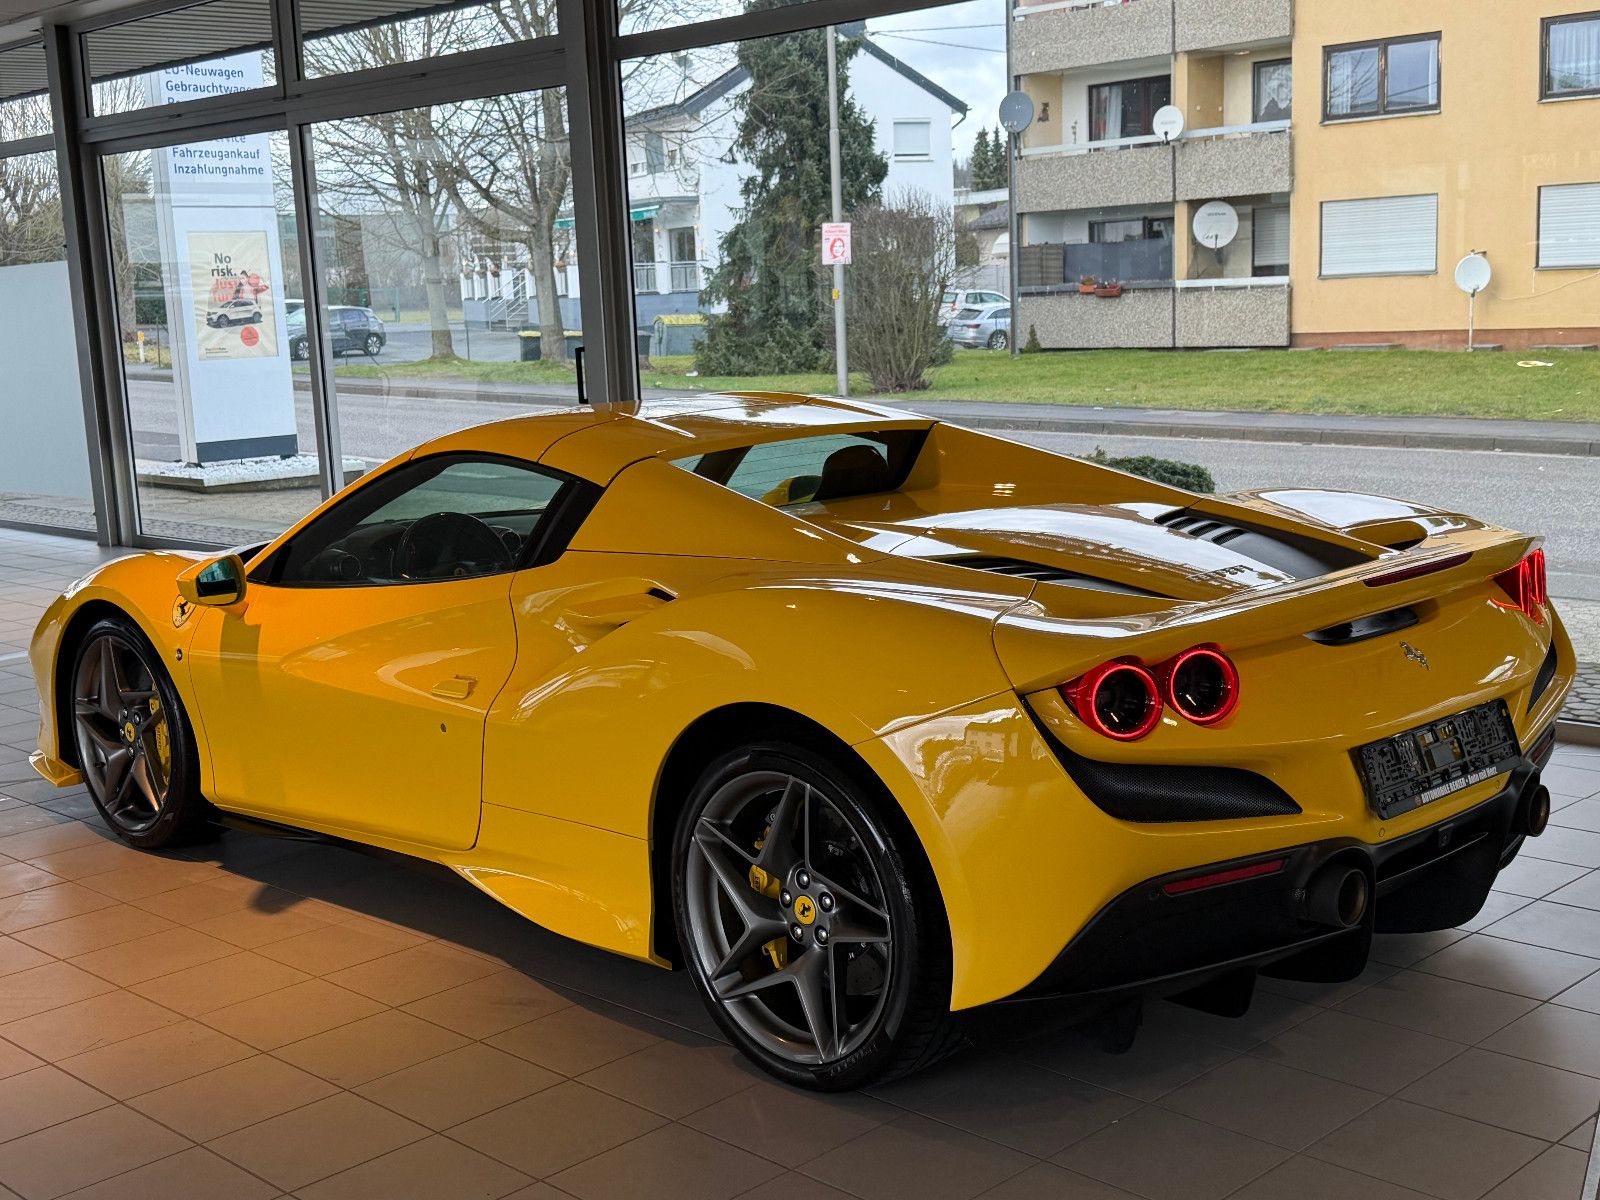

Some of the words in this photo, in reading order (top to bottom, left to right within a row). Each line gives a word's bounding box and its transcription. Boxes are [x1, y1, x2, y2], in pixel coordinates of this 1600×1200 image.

[172, 147, 260, 160] Fahrzeugankauf
[174, 163, 264, 176] Inzahlungnahme
[214, 253, 232, 264] No
[211, 265, 237, 277] risk.
